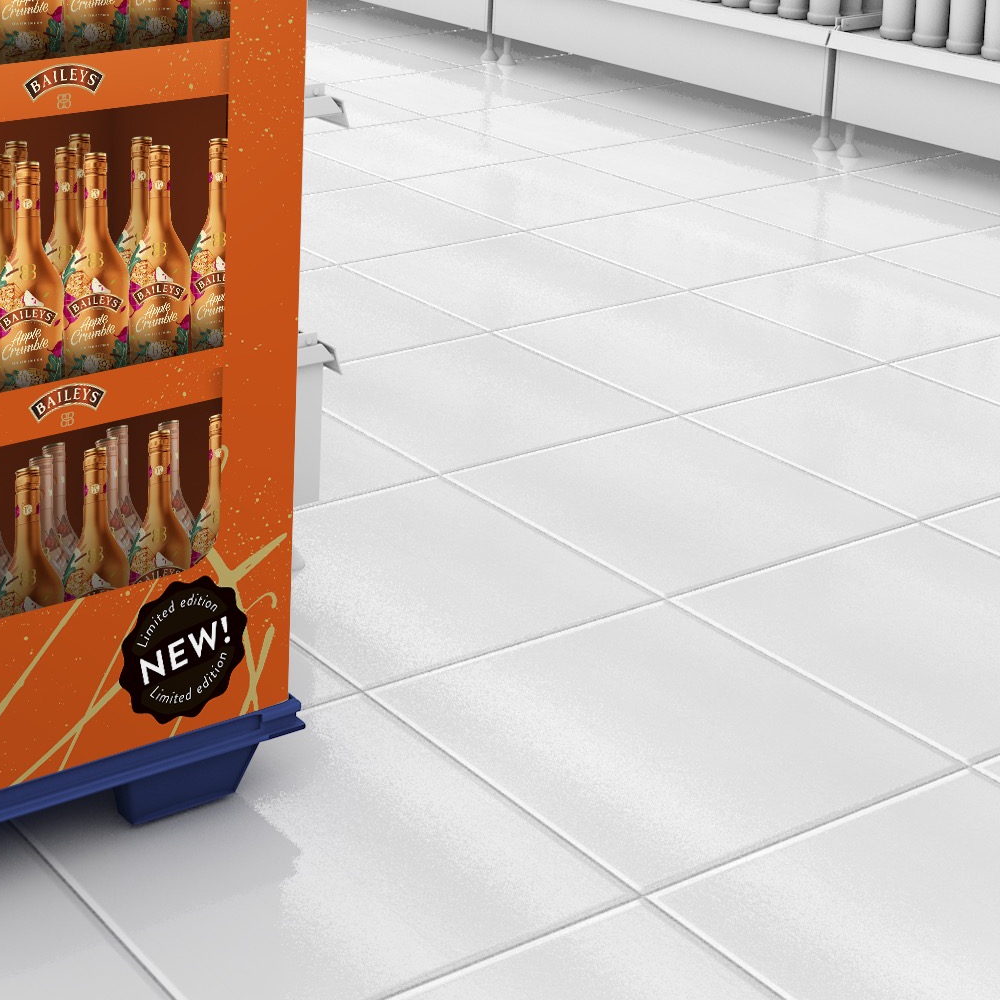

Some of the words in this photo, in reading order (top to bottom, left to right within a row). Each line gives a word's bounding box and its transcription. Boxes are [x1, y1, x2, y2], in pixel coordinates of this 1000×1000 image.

[1, 1, 49, 21] Crumble
[30, 68, 98, 94] BAILEYS
[198, 273, 226, 290] BAIL
[137, 284, 182, 301] BAILEYS
[72, 295, 119, 314] BAILEYS
[144, 301, 171, 319] Apple
[197, 305, 225, 321] Crum
[2, 309, 53, 327] BAILEYS
[81, 313, 109, 330] Apple
[135, 312, 178, 333] Crumble
[12, 328, 42, 347] Apple
[70, 322, 115, 346] Crumble
[1, 337, 49, 361] Crumble
[35, 387, 100, 416] BAILEYS
[136, 600, 176, 648] Limited
[180, 593, 218, 613] edition
[139, 615, 232, 686] NEW!
[149, 685, 192, 704] Limited
[196, 652, 228, 694] edition
